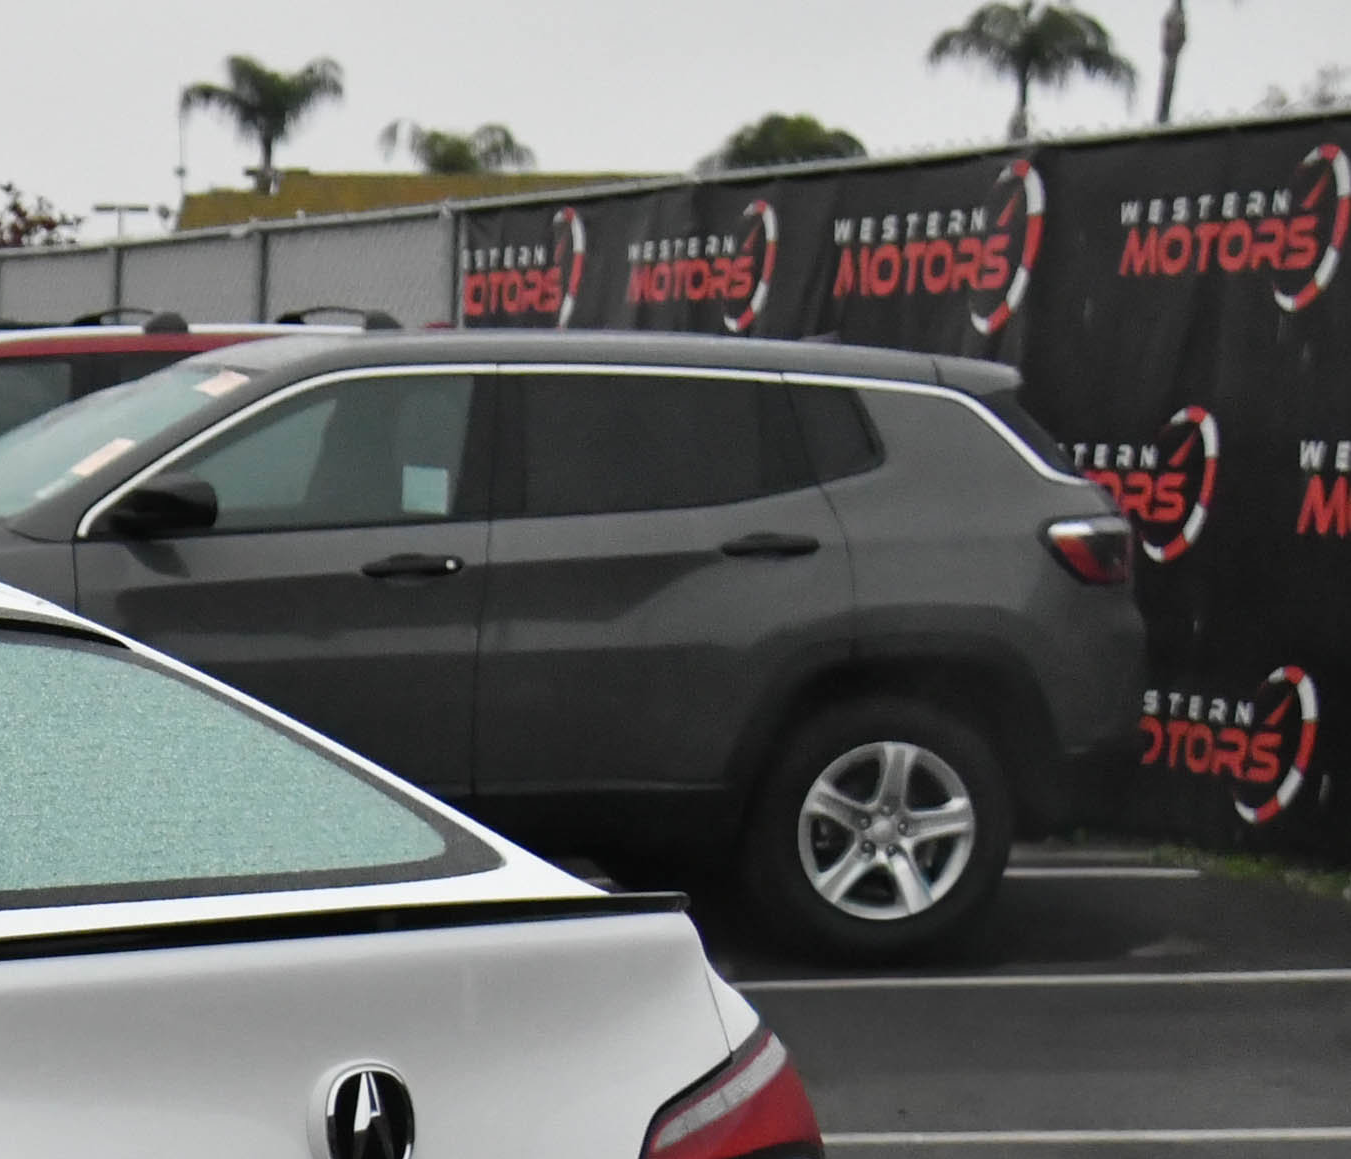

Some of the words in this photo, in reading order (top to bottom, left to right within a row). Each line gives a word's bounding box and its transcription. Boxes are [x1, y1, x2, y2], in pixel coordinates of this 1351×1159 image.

[834, 206, 987, 246] WESTERN
[1120, 187, 1292, 225] WESTERN
[628, 234, 737, 262] WESTERN
[832, 233, 1011, 297] MOTORS
[1118, 214, 1319, 277] MOTORS
[463, 266, 562, 316] OTORS
[627, 254, 756, 305] MOTORS
[1057, 442, 1159, 470] TERN
[1143, 690, 1255, 727] STERN
[1139, 714, 1282, 782] OTORS
